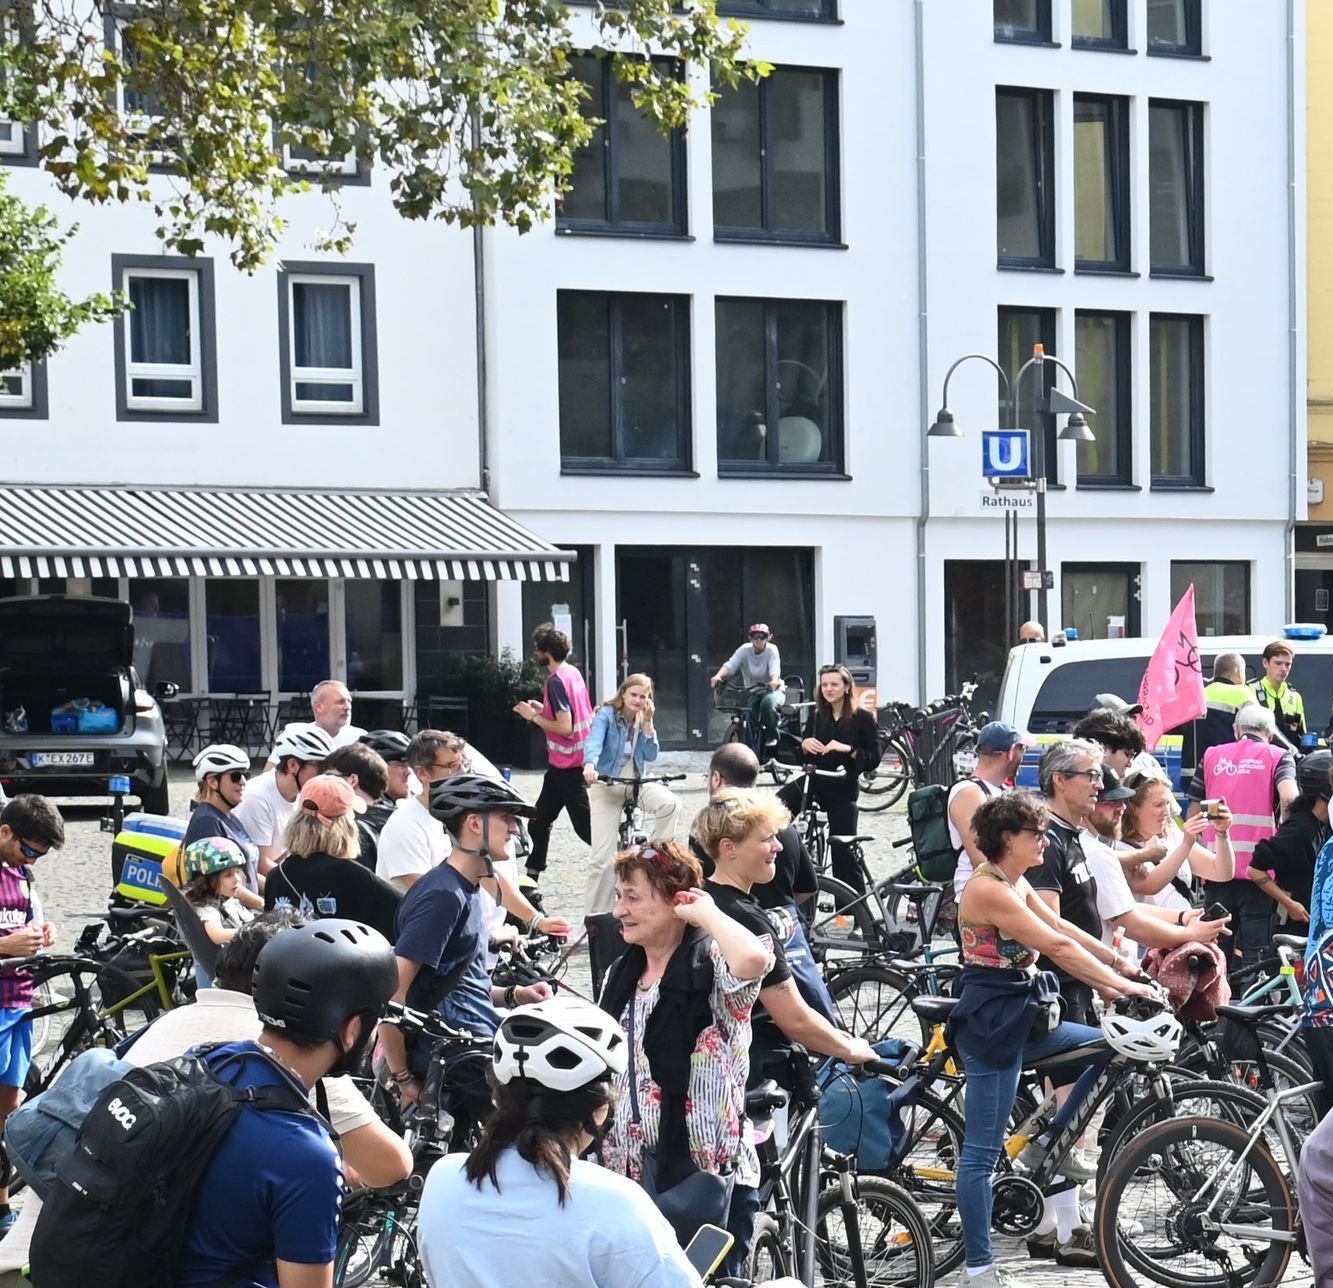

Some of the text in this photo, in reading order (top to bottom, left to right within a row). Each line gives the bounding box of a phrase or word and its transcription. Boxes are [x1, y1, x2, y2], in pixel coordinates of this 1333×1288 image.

[989, 436, 1021, 471] U
[982, 496, 1032, 507] Rathaus
[126, 864, 162, 888] POLI
[1043, 1067, 1108, 1177] STEVENS
